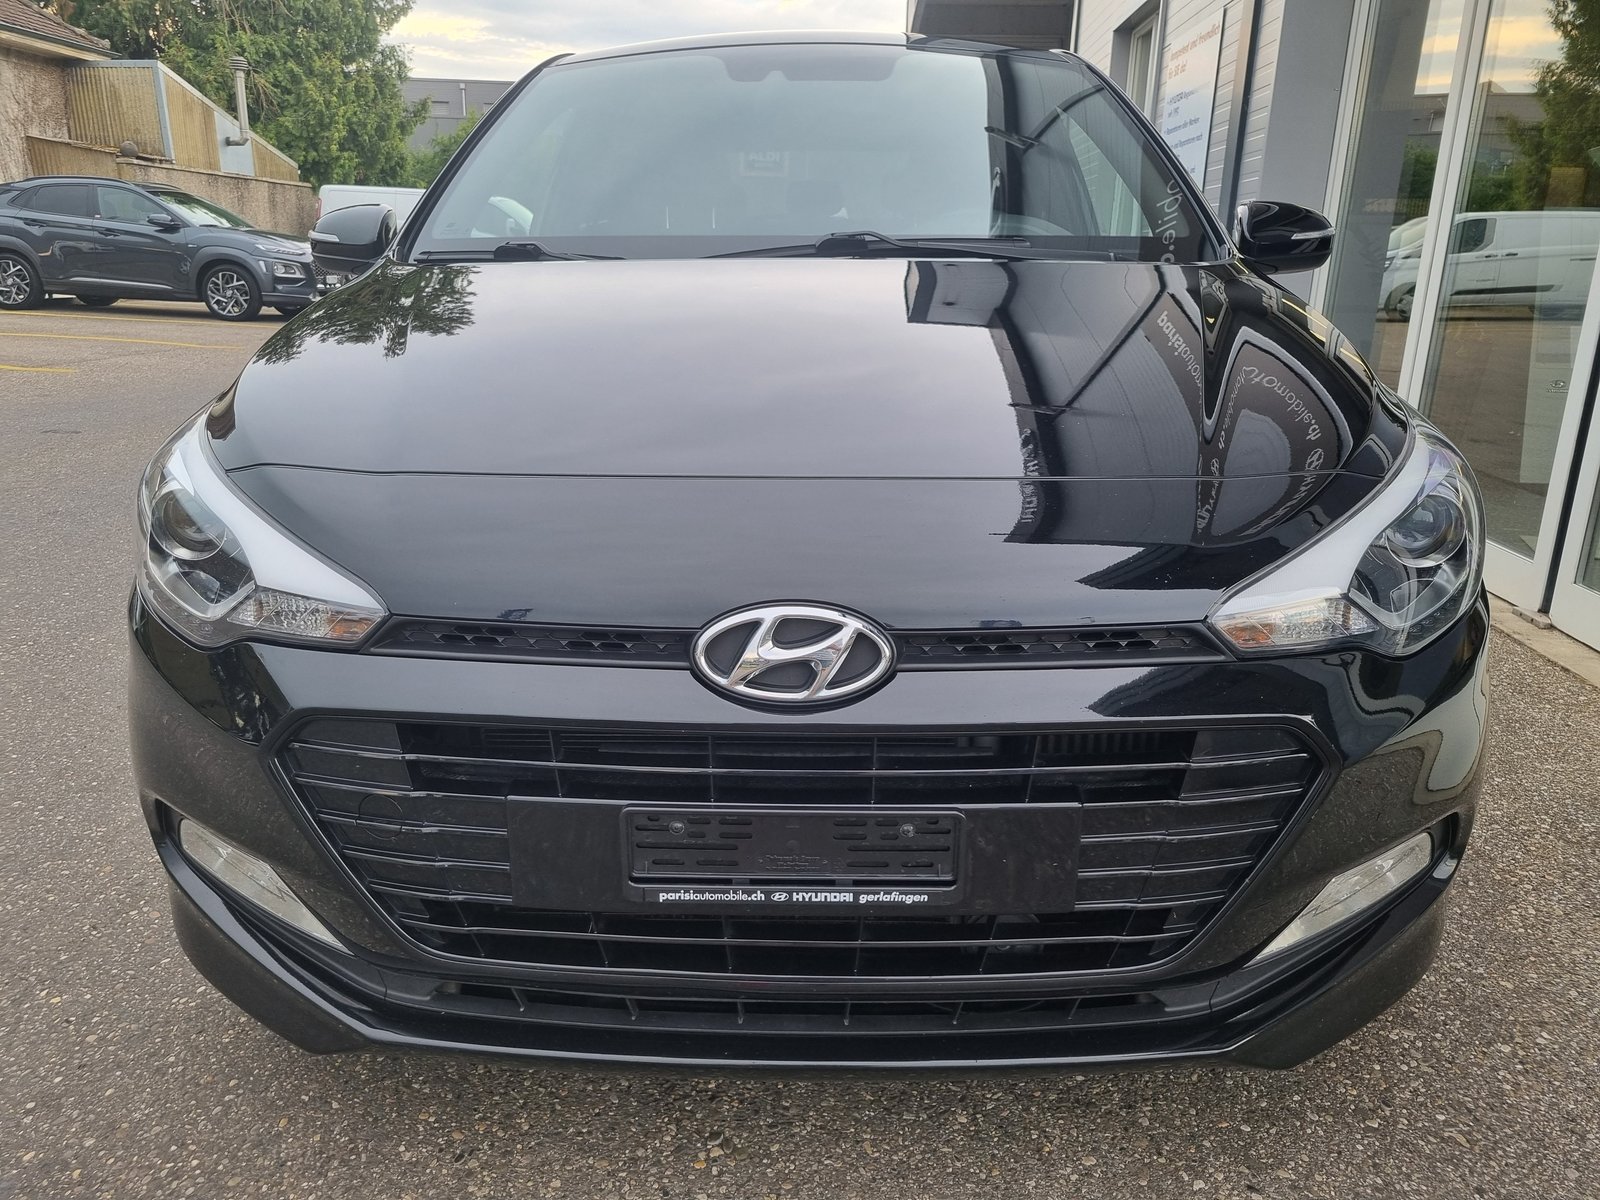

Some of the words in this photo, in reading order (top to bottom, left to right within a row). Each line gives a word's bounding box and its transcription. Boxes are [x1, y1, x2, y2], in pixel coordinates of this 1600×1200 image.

[658, 889, 766, 904] parisiautomobile.ch
[792, 891, 854, 903] HYUNDAI
[858, 891, 929, 905] gerlafingen
